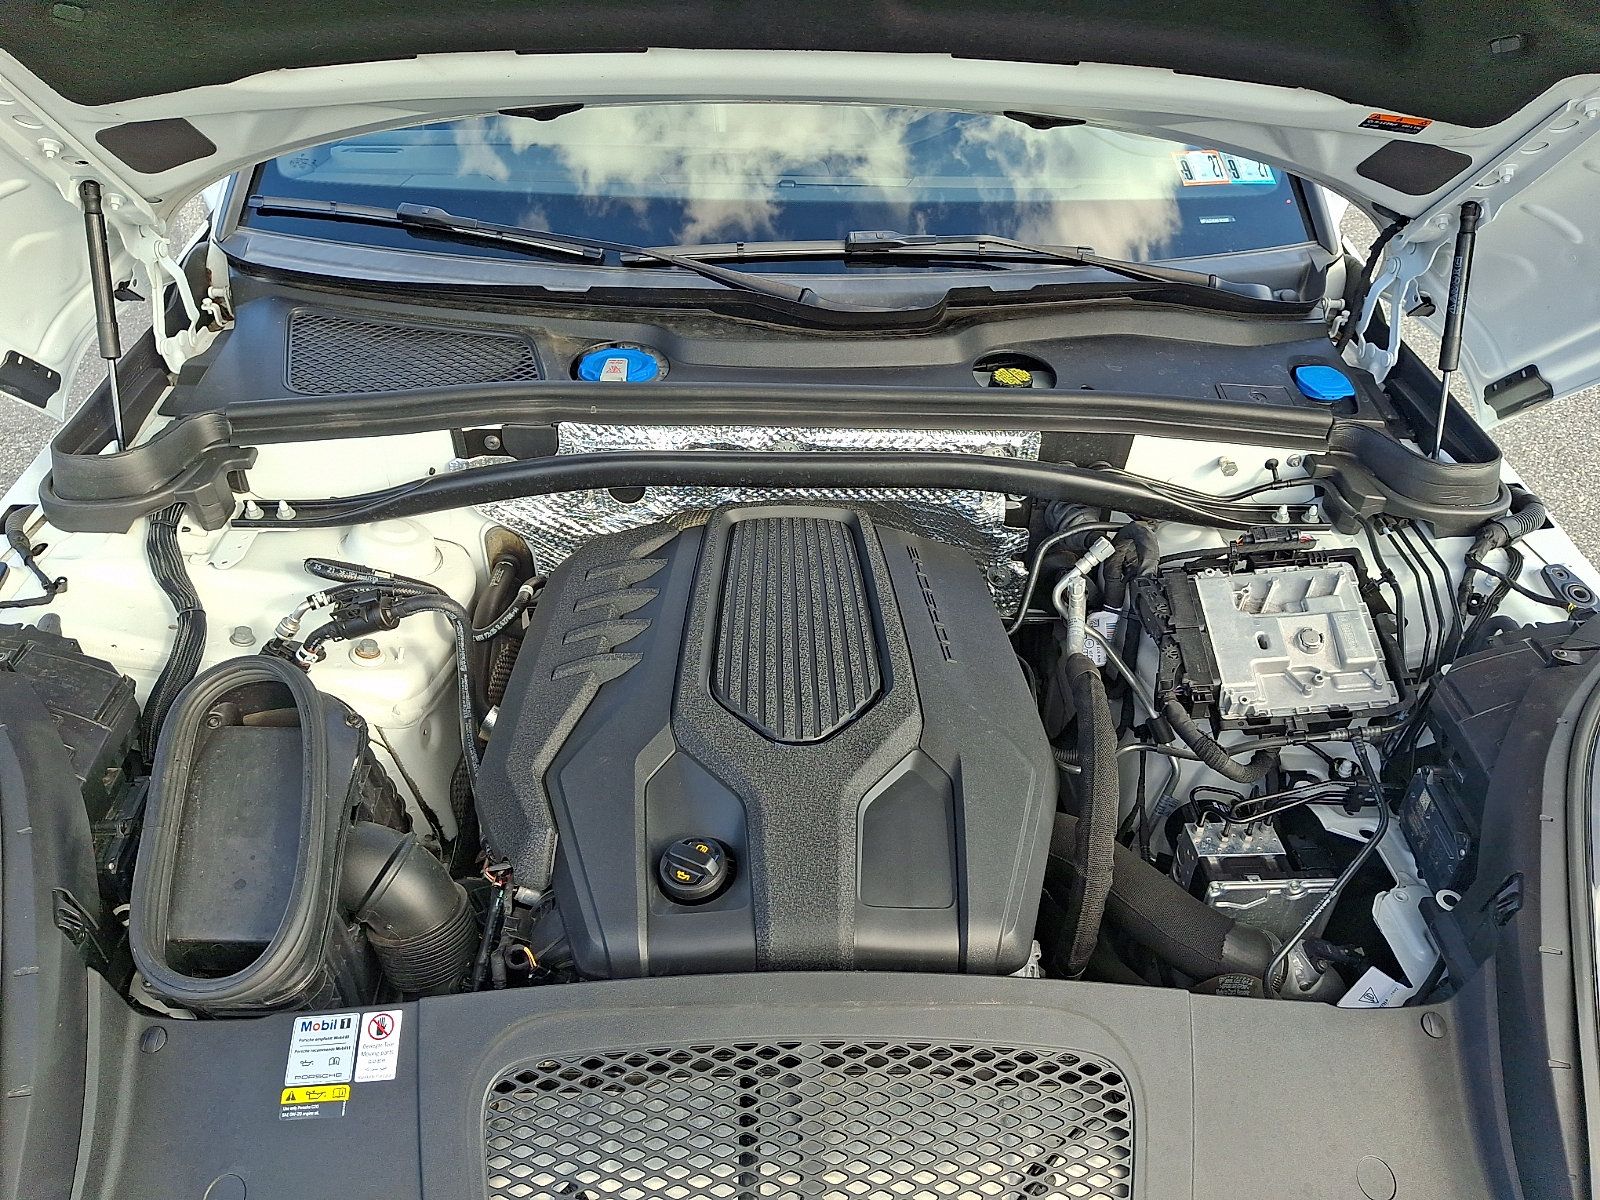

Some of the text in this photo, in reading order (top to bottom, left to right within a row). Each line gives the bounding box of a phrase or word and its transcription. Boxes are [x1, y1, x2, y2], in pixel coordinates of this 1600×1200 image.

[1180, 159, 1194, 180] 9
[1227, 159, 1240, 179] 9
[906, 545, 958, 664] PORSCHE
[300, 1017, 351, 1032] Mobil 1
[294, 1072, 342, 1080] PORSCHE
